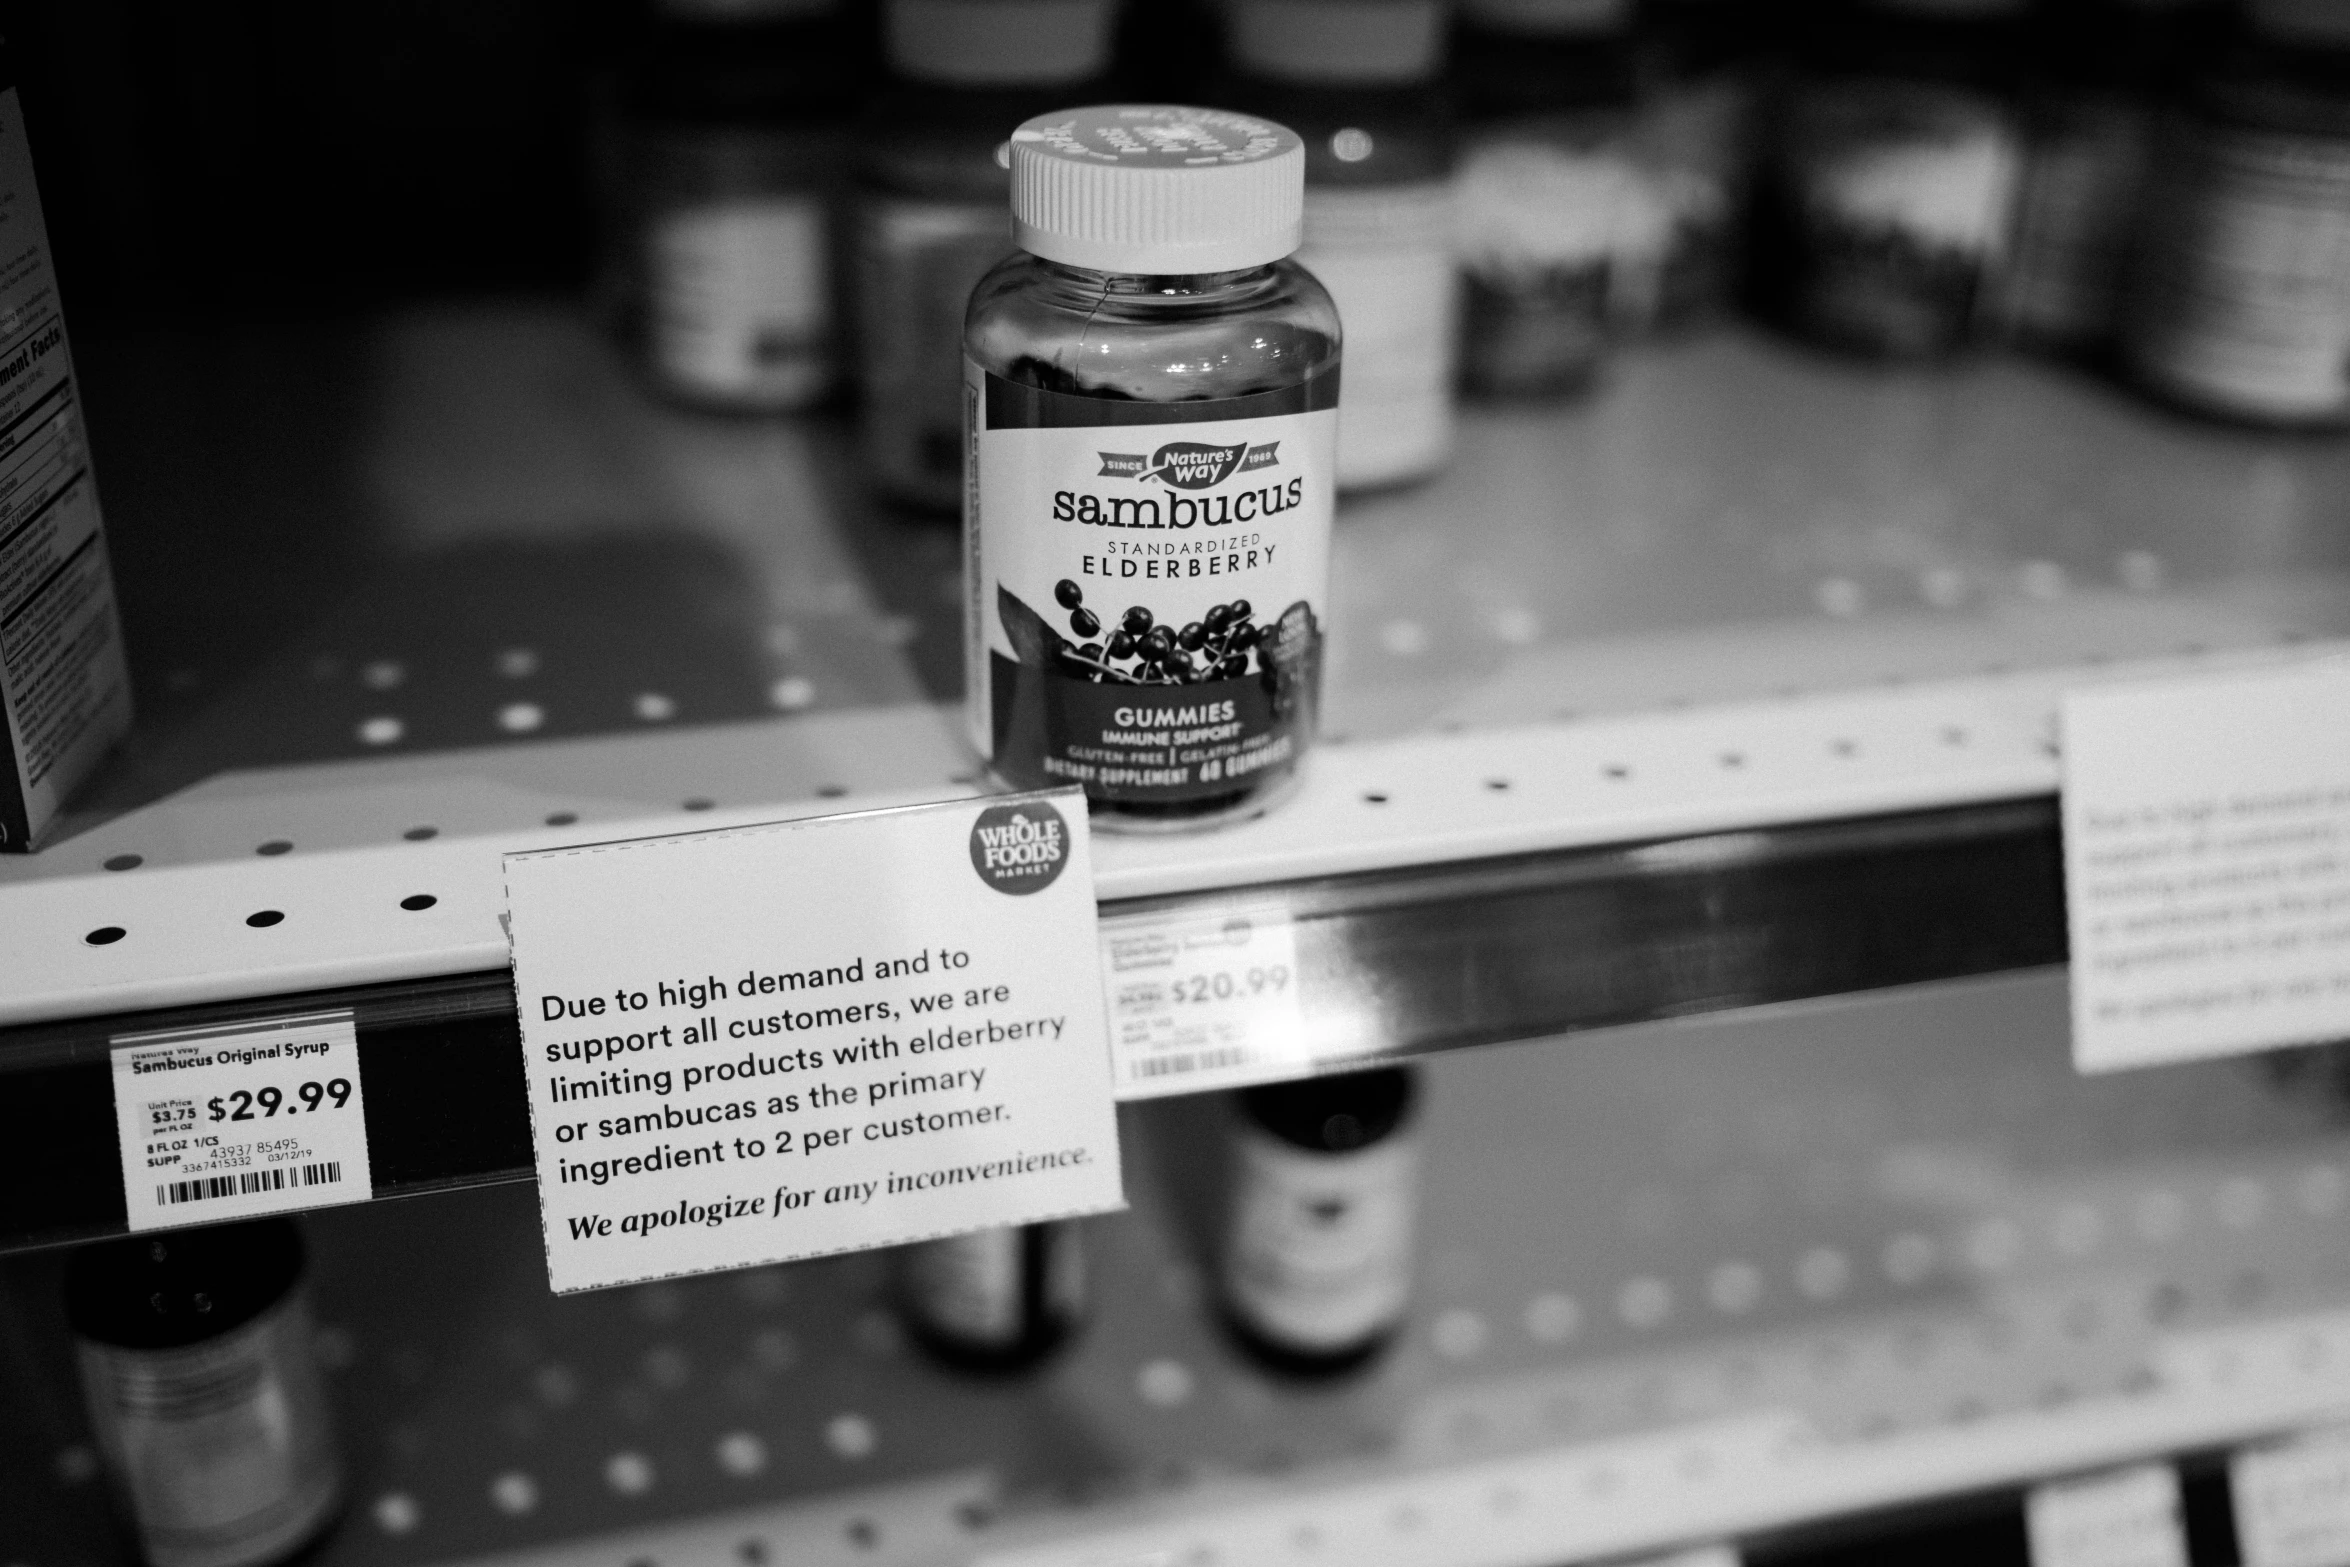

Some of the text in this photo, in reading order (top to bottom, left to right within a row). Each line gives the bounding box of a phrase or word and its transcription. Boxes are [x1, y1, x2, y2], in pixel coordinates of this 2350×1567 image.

[30, 327, 60, 361] Facts
[1107, 460, 1143, 471] SINCE
[1164, 448, 1234, 467] Nature's
[1249, 452, 1272, 464] 1969
[1174, 463, 1223, 484] Way
[1053, 476, 1303, 529] sambucus
[1108, 533, 1260, 555] STANDARDIZED
[1083, 545, 1276, 579] ELDERBERRY
[1114, 700, 1236, 727] GUMMIES
[1102, 721, 1243, 746] IMMUNE SUPPORT
[1099, 766, 1189, 786] SUPPLEMENT
[978, 819, 1061, 847] WHOLE
[984, 840, 1061, 868] FOODS
[995, 863, 1049, 878] MARKET
[541, 948, 971, 1022] Due to high demand and to
[1171, 964, 1289, 1004] $20.99
[545, 984, 1010, 1064] support all customers, we are
[132, 1042, 330, 1075] Sambucus Original Syrup
[550, 1016, 1066, 1103] limiting products with elderberry
[148, 1099, 192, 1110] Unit Price
[207, 1078, 352, 1123] $29.99
[555, 1067, 986, 1143] or sambucas as the primary
[152, 1107, 197, 1124] $3.75
[153, 1122, 193, 1136] per FL OZ
[147, 1136, 219, 1154] 8 FL OZ 1/CS
[210, 1138, 299, 1159] 43937 85495
[560, 1104, 1012, 1185] ingredient to 2 per customer.
[147, 1155, 182, 1168] SUPP
[181, 1149, 313, 1174] 3367415332 03/12/19
[568, 1147, 1095, 1241] We apologize for any inconvenience.
